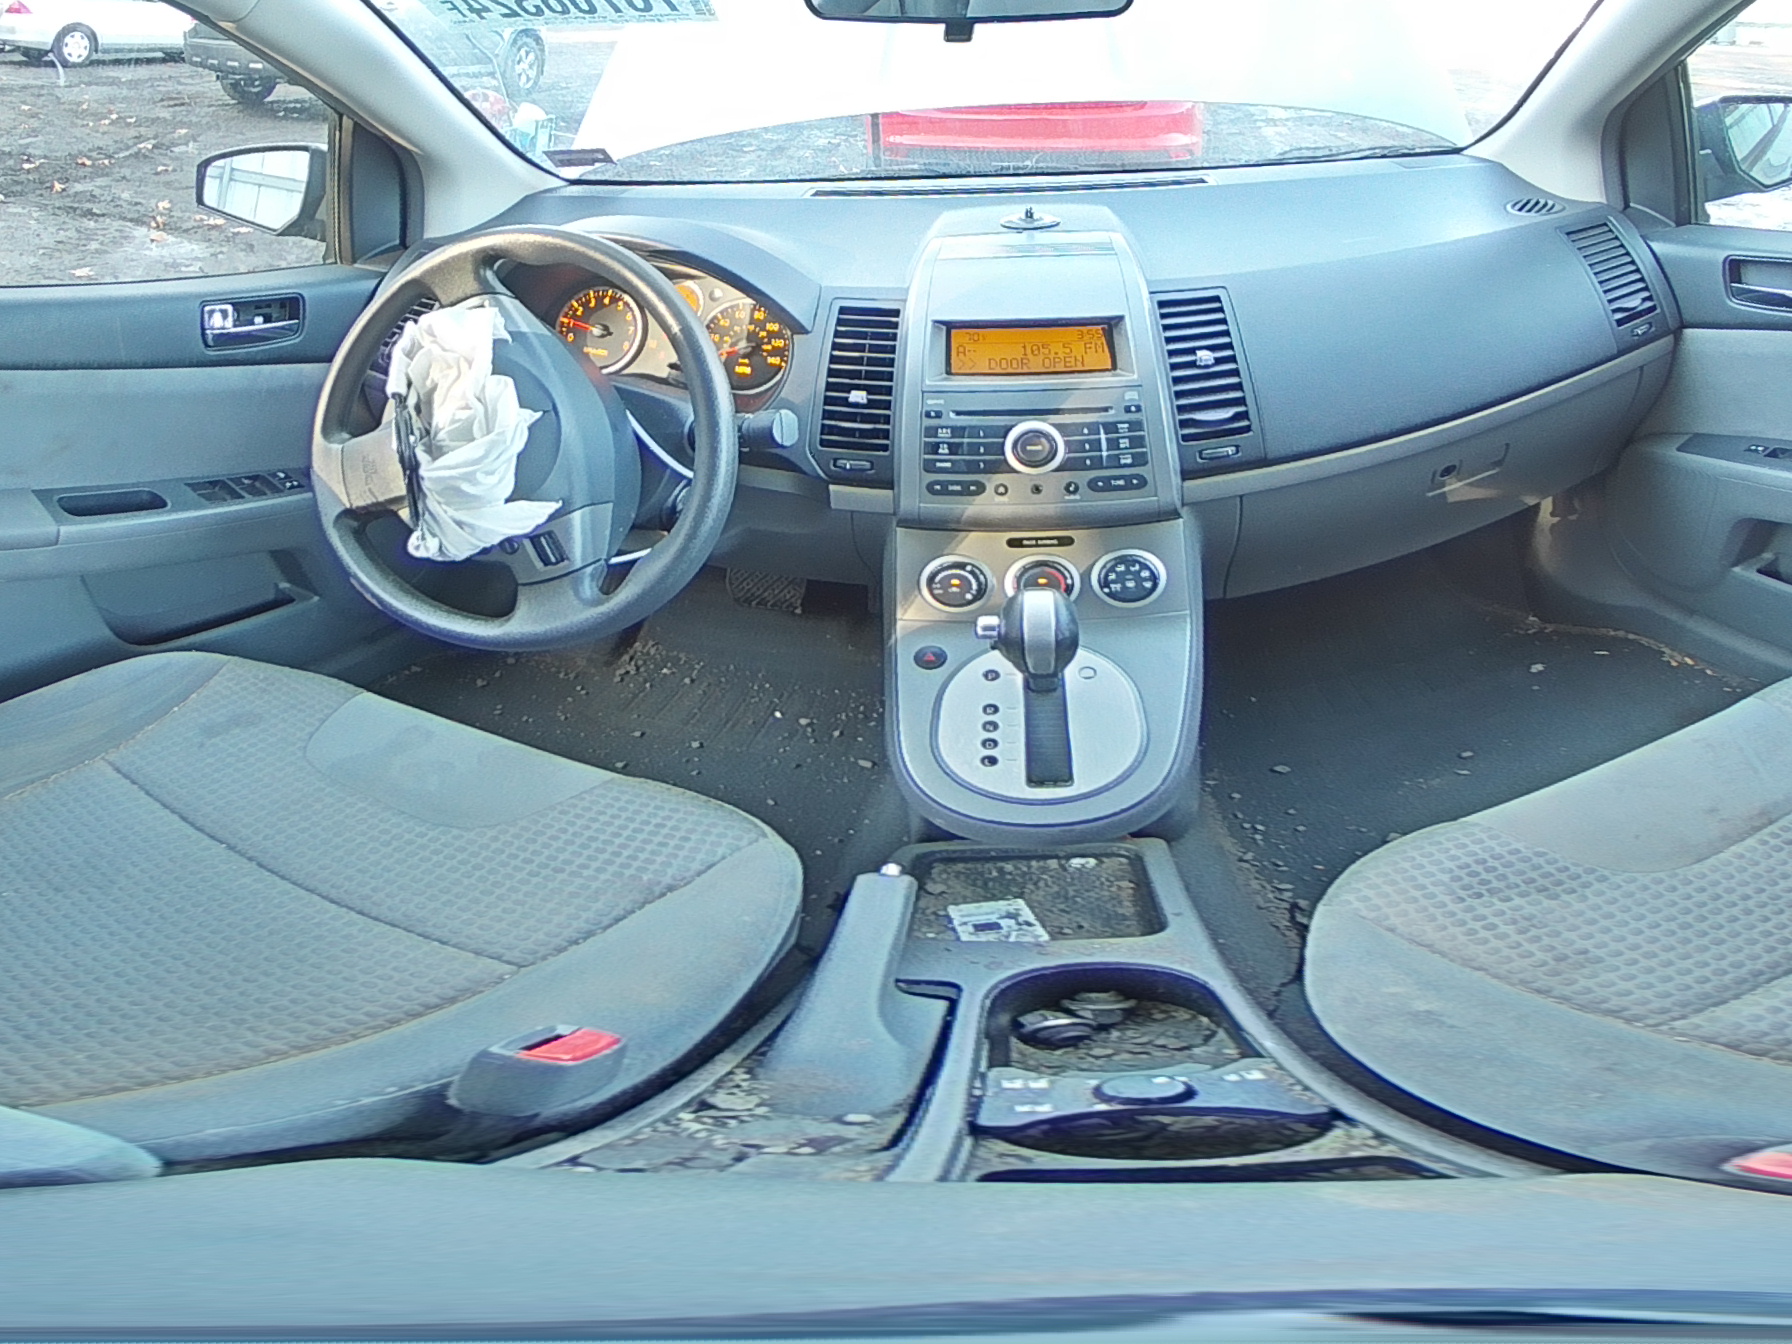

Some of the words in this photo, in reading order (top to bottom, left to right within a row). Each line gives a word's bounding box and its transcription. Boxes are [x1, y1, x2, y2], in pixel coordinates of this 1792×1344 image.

[766, 322, 779, 332] 100
[567, 332, 575, 342] 0
[1021, 342, 1073, 357] 105.5
[1084, 341, 1106, 355] FM
[988, 357, 1030, 371] DOOR
[1041, 355, 1086, 369] OPEN
